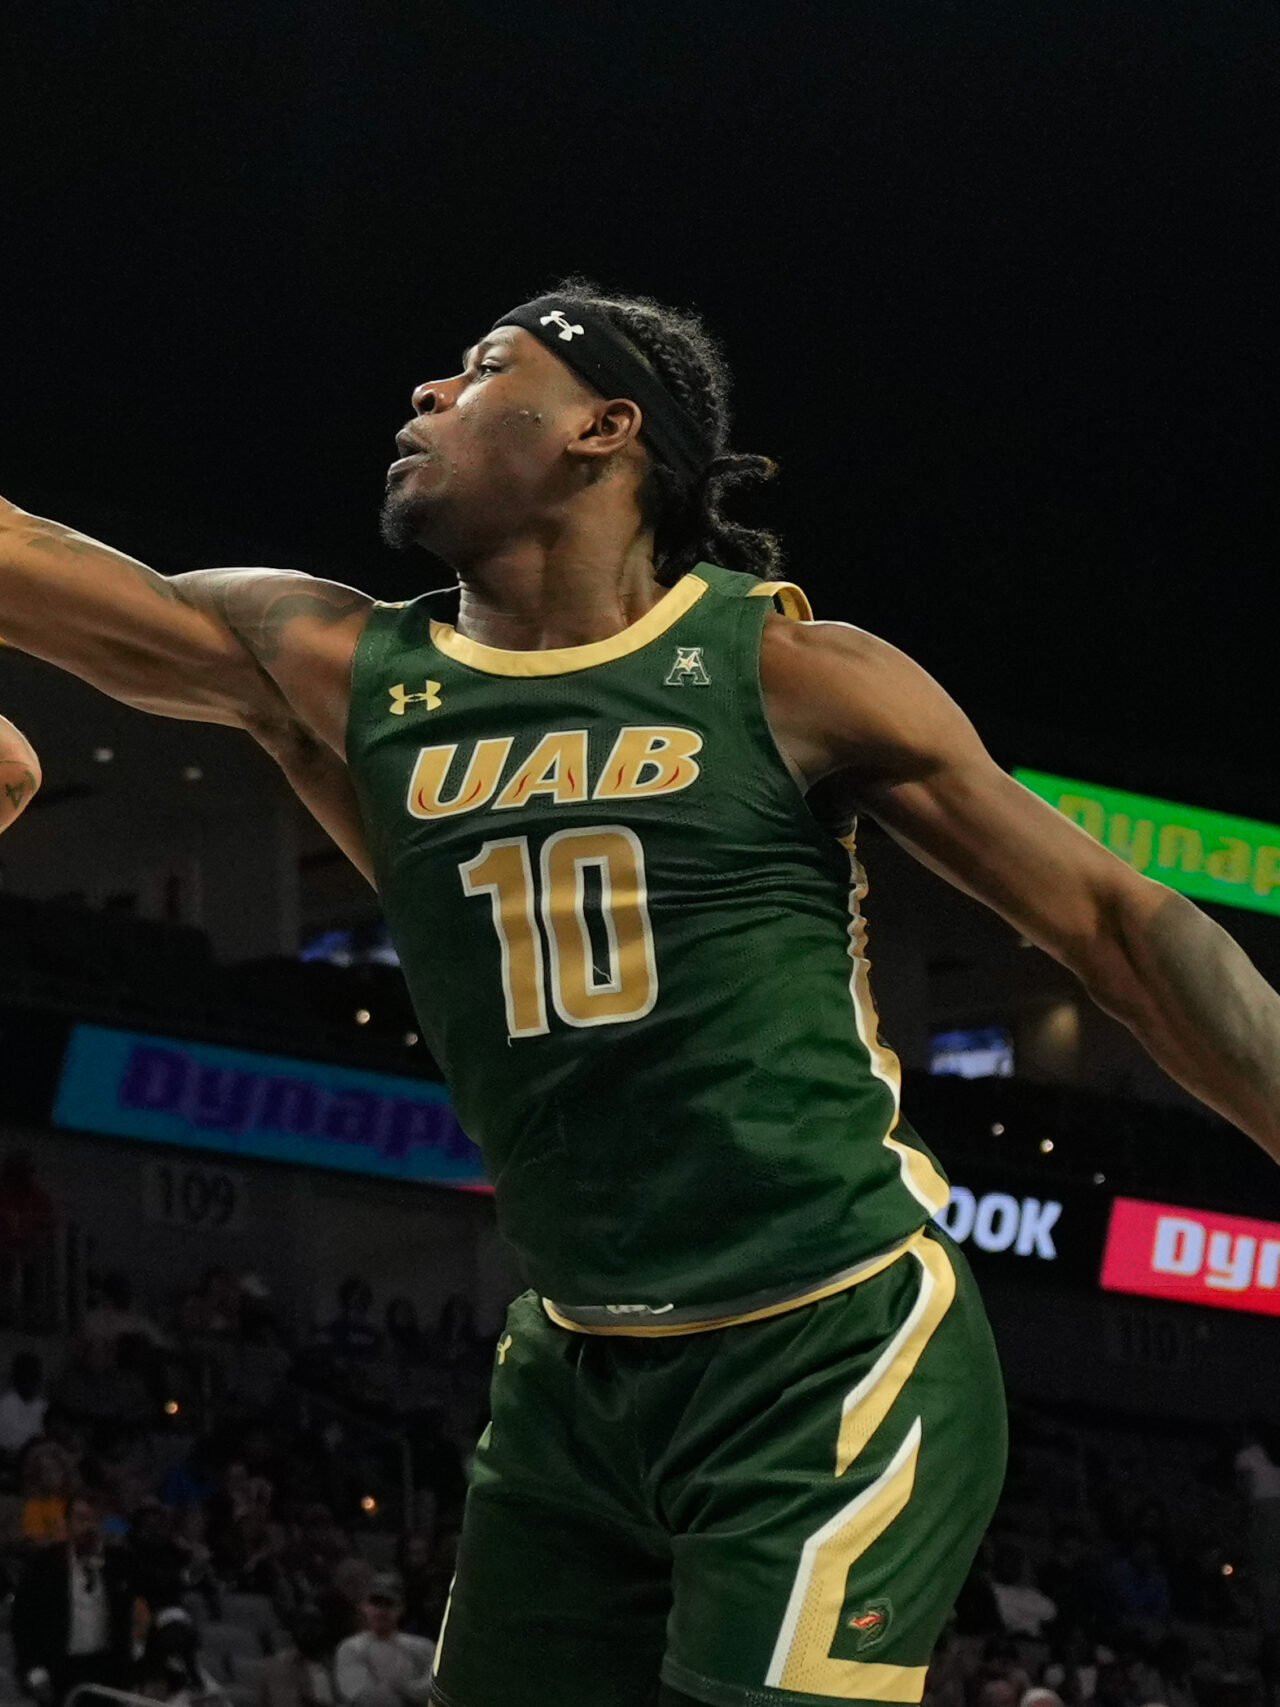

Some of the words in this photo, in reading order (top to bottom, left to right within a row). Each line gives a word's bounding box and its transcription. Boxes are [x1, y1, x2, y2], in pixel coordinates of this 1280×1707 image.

[406, 725, 703, 820] UAB
[458, 824, 660, 1038] 10
[159, 1168, 237, 1226] 109
